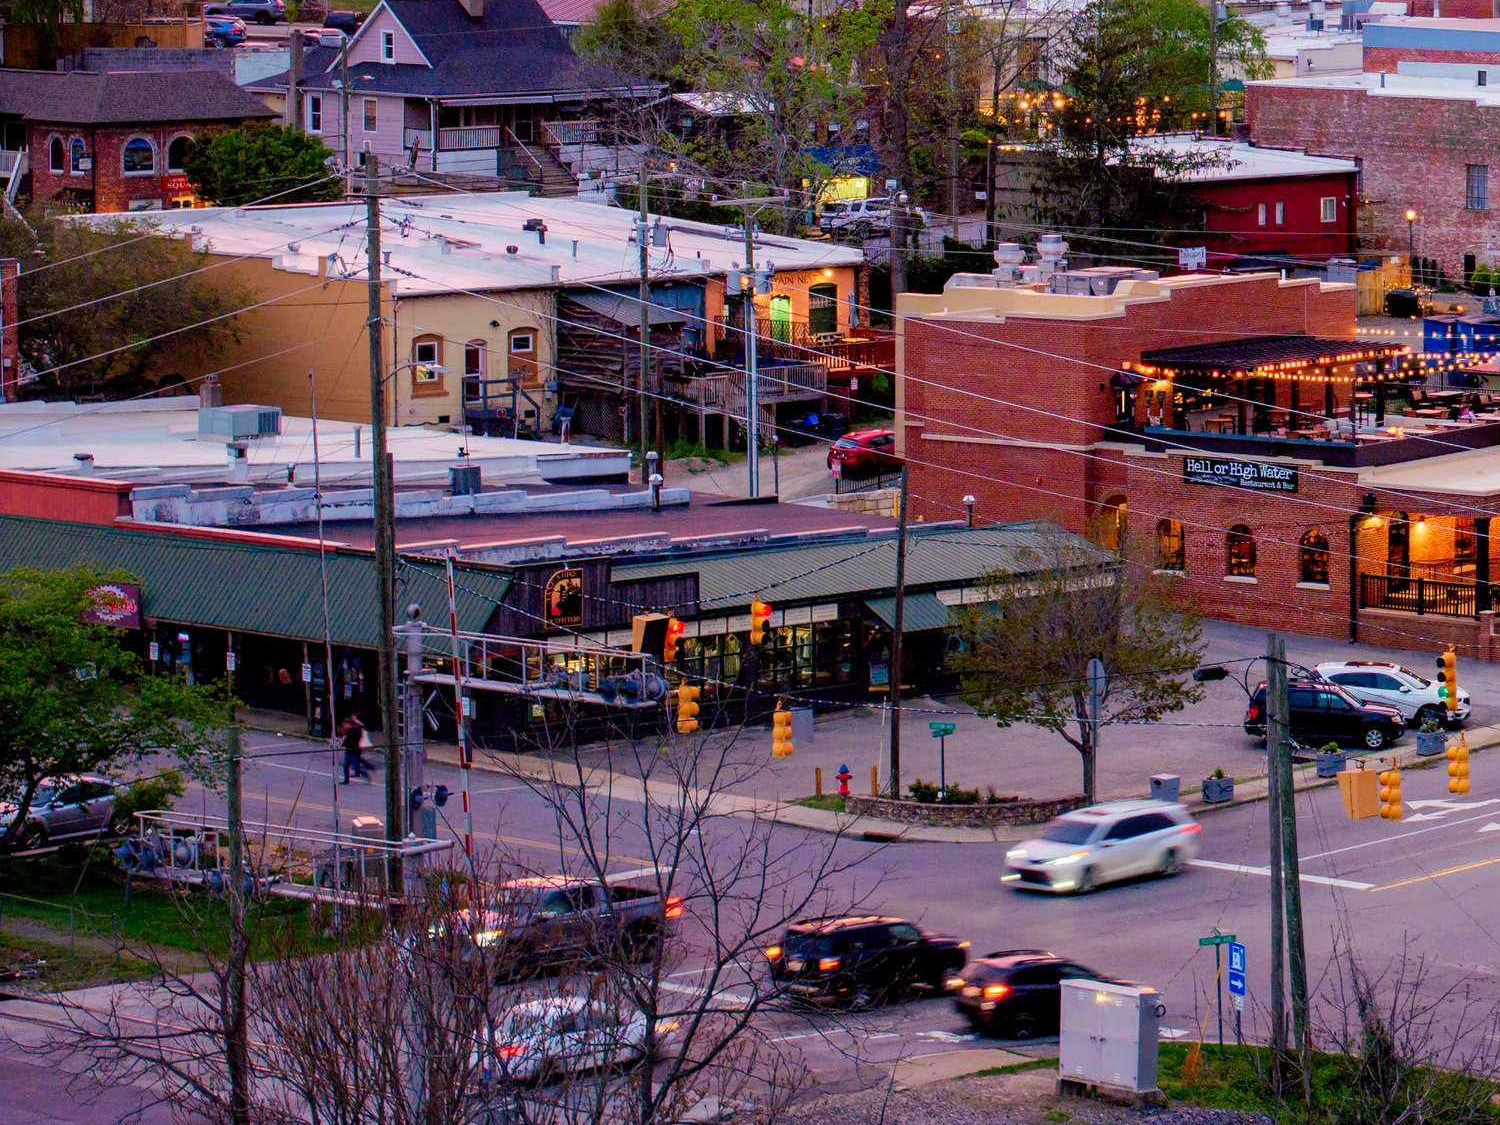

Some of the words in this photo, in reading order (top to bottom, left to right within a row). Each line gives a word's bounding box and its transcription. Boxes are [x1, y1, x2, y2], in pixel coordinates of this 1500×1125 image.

[1186, 459, 1213, 473] Hell
[1214, 465, 1228, 475] or
[1229, 462, 1258, 480] High
[1259, 465, 1293, 479] Water
[1240, 479, 1275, 488] Restaurant
[1282, 482, 1295, 490] Bar
